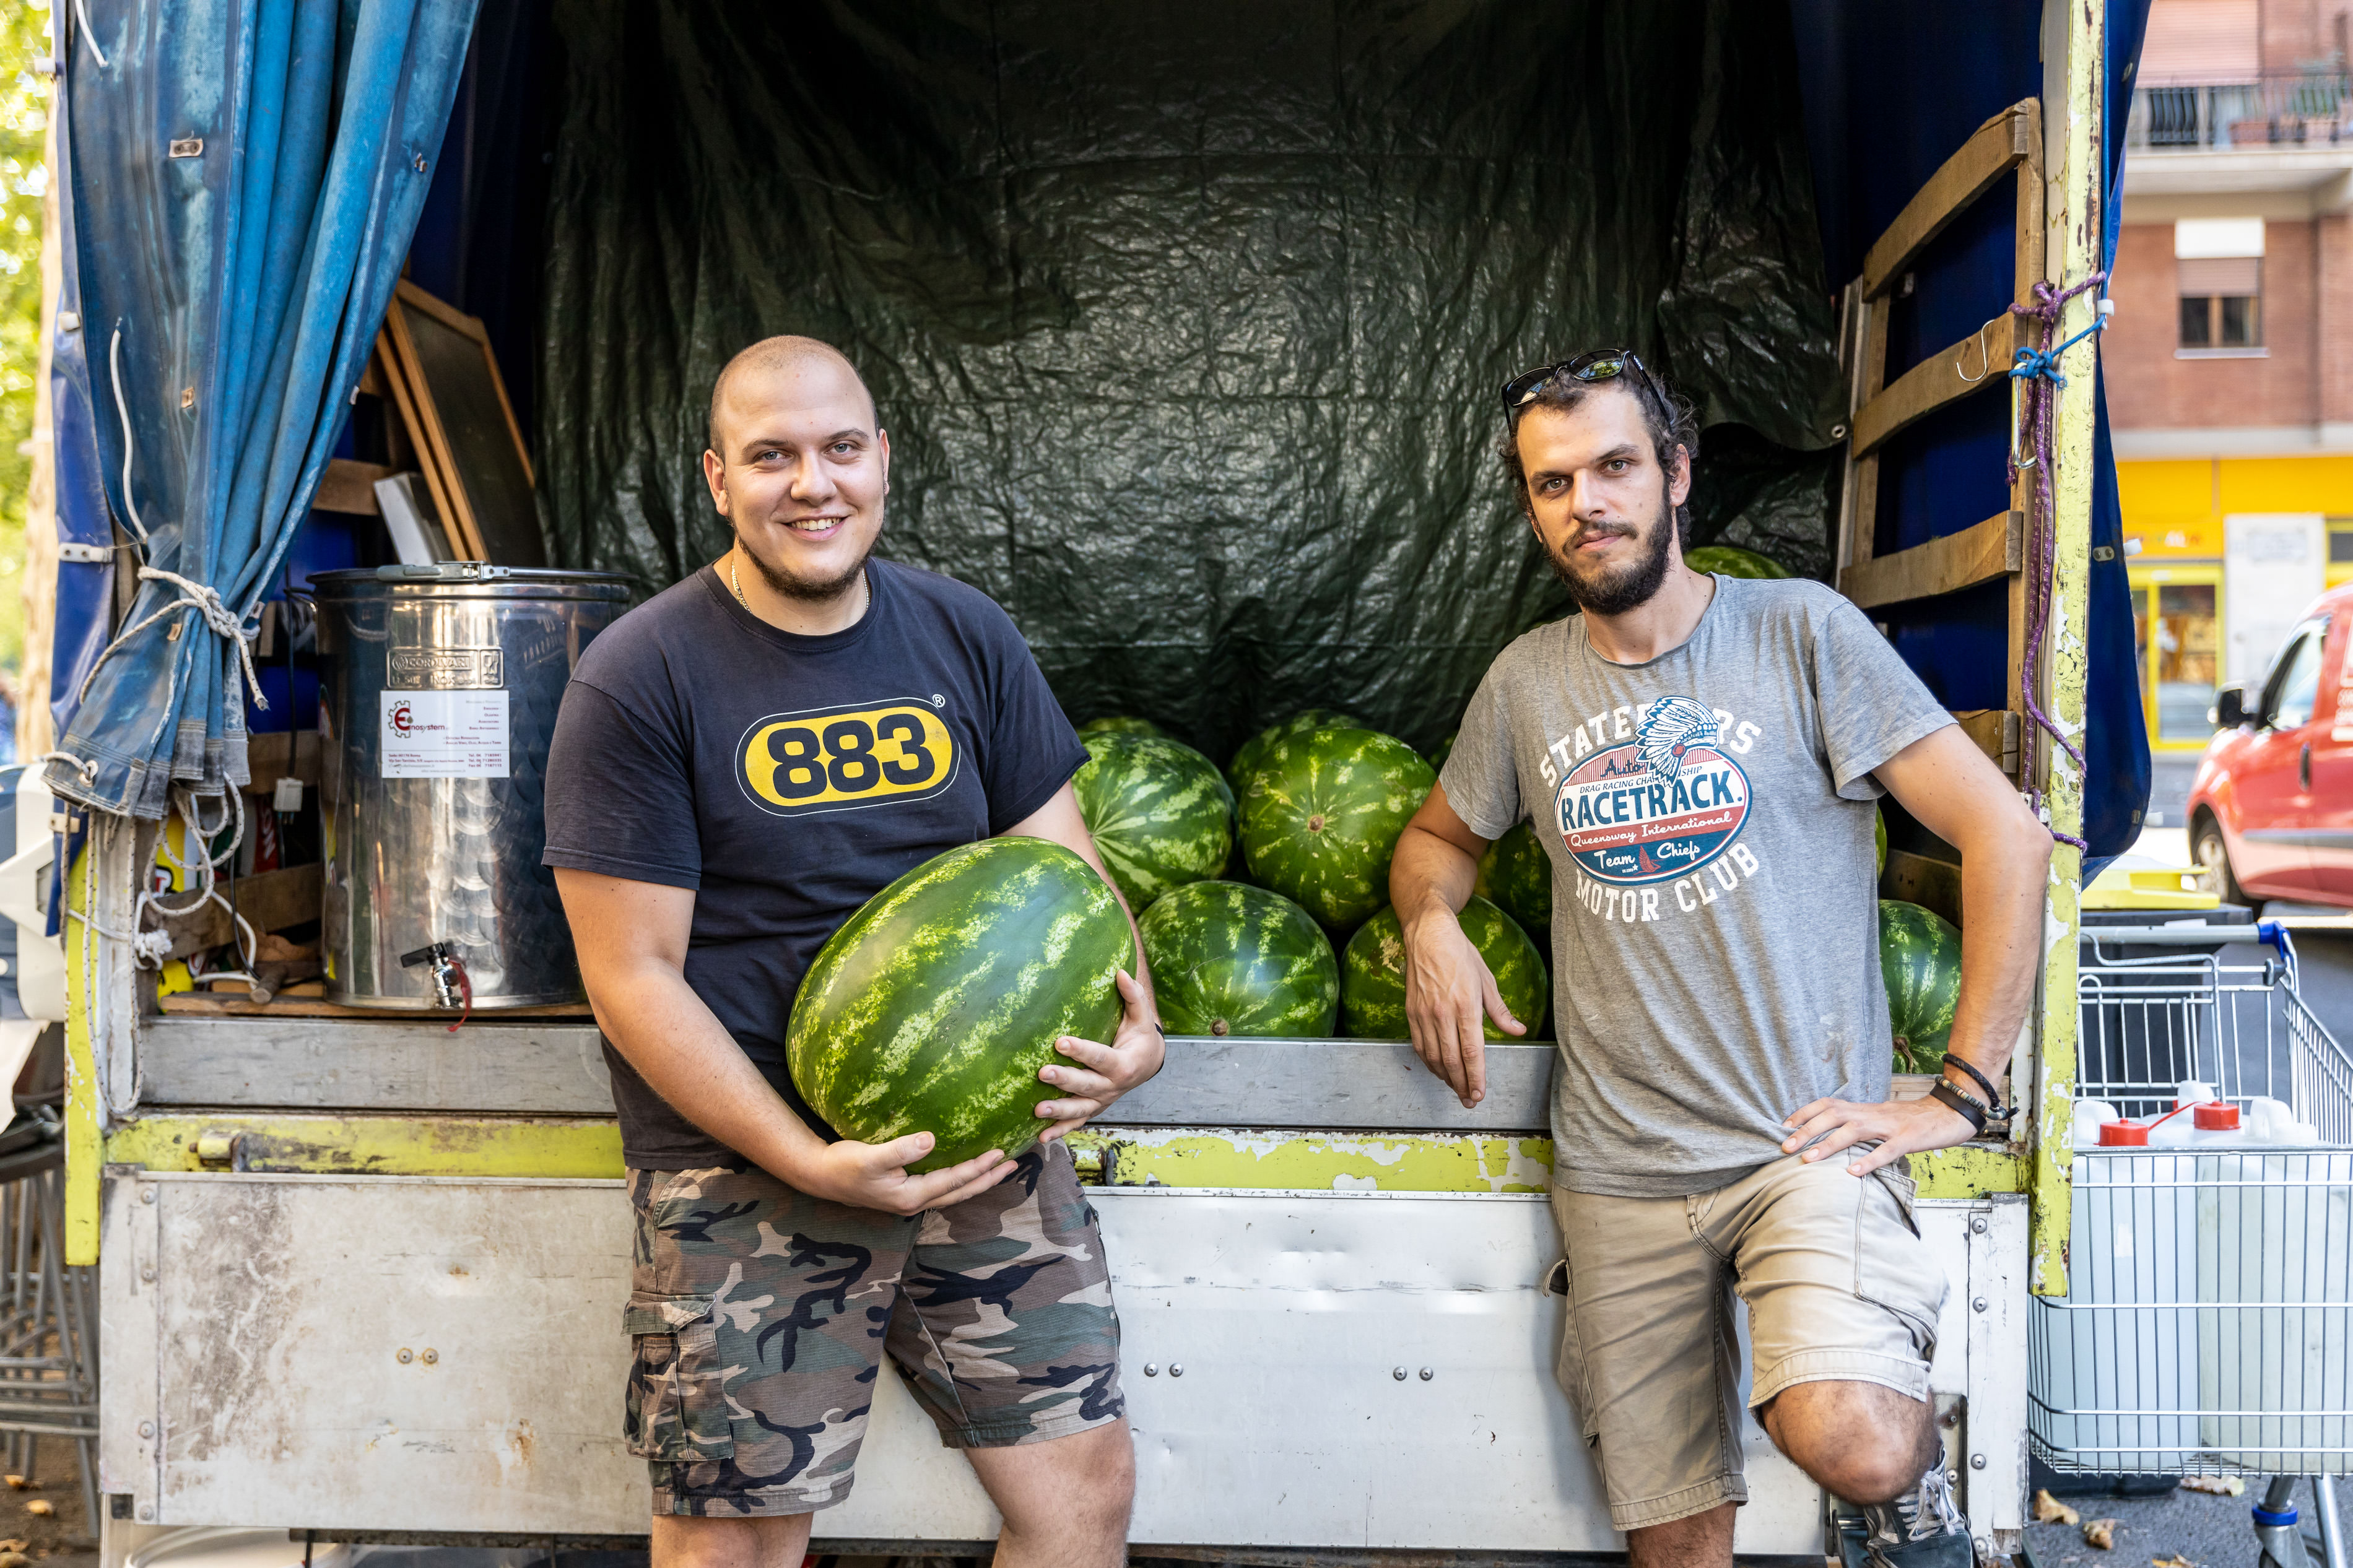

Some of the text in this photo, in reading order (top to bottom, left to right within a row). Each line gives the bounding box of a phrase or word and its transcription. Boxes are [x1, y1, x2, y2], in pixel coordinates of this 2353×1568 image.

[409, 657, 469, 669] CORDIVARI
[767, 713, 935, 799] 883
[1600, 759, 1644, 777] Auto
[1580, 784, 1601, 794] DRAG
[1603, 778, 1633, 790] RACING
[1570, 811, 1733, 847] Queensway International
[1594, 841, 1700, 869] Team Chiefs
[1575, 842, 1759, 923] MOTOR CLUB
